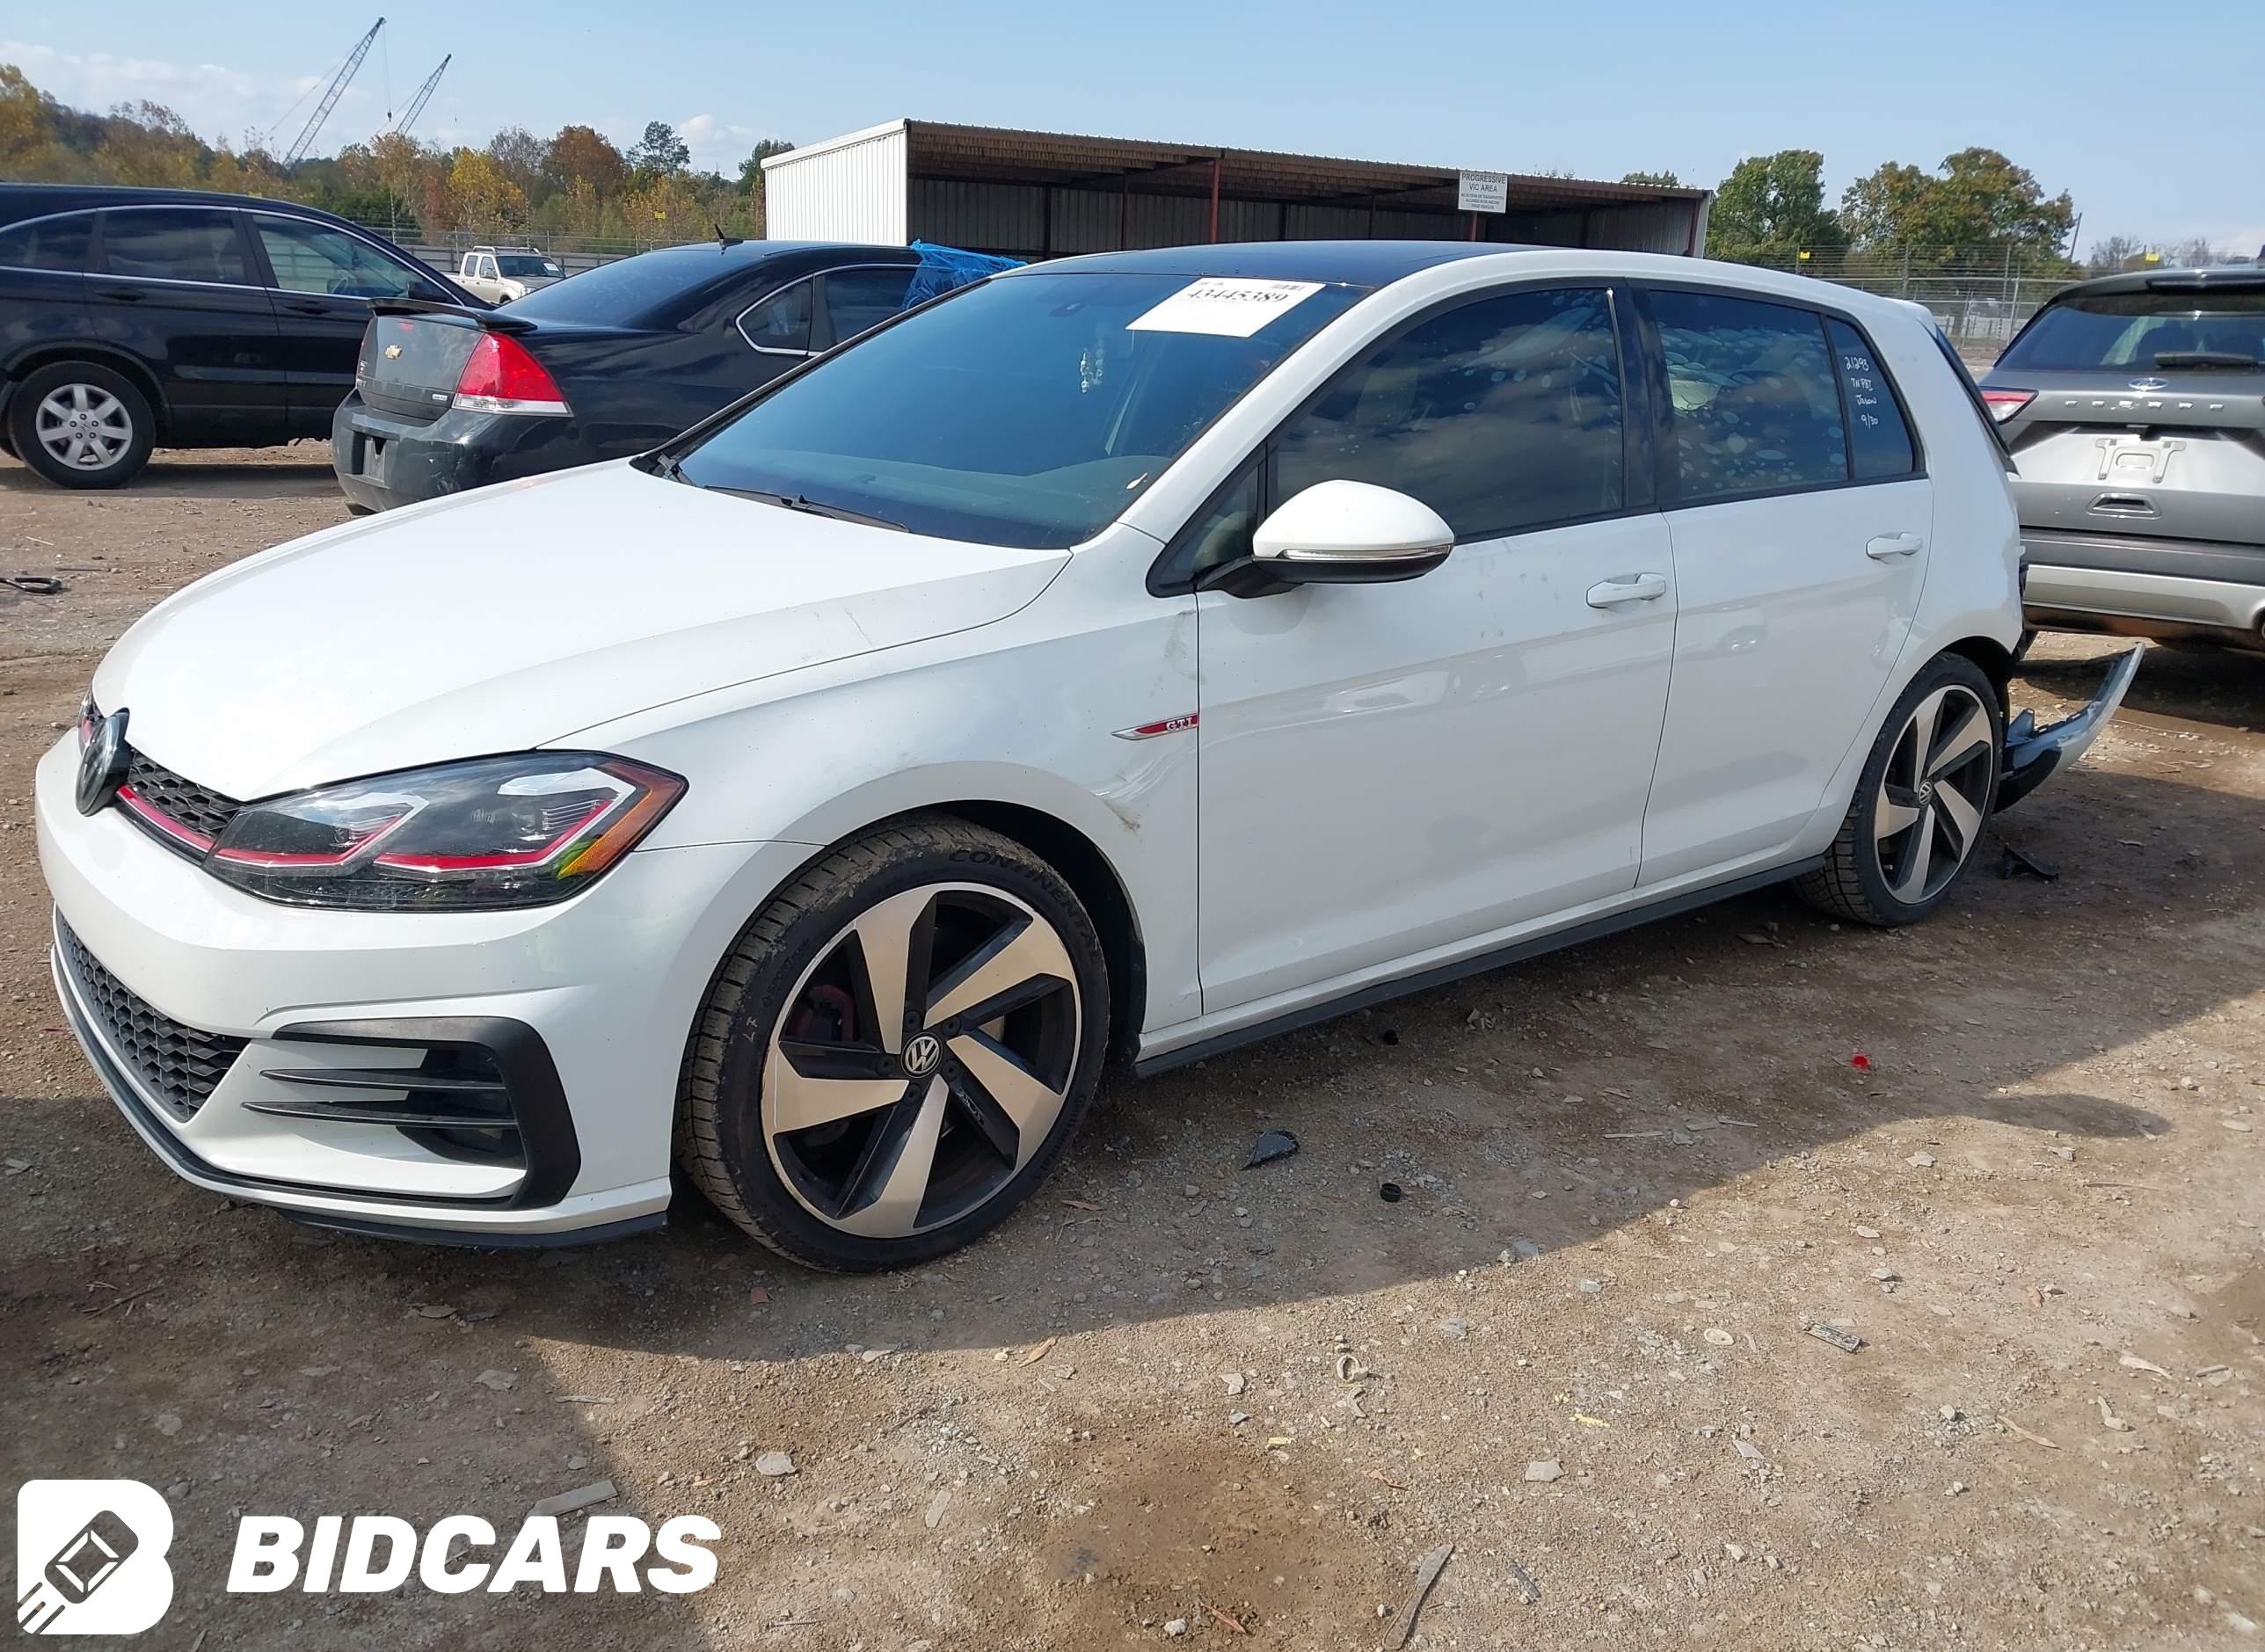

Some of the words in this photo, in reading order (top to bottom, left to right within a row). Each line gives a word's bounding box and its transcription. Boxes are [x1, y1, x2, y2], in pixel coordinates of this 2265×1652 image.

[1461, 173, 1506, 184] PROGRESSIVE
[1481, 184, 1498, 193] AREA
[1861, 412, 1879, 429] 9/30
[1167, 717, 1193, 731] GTI
